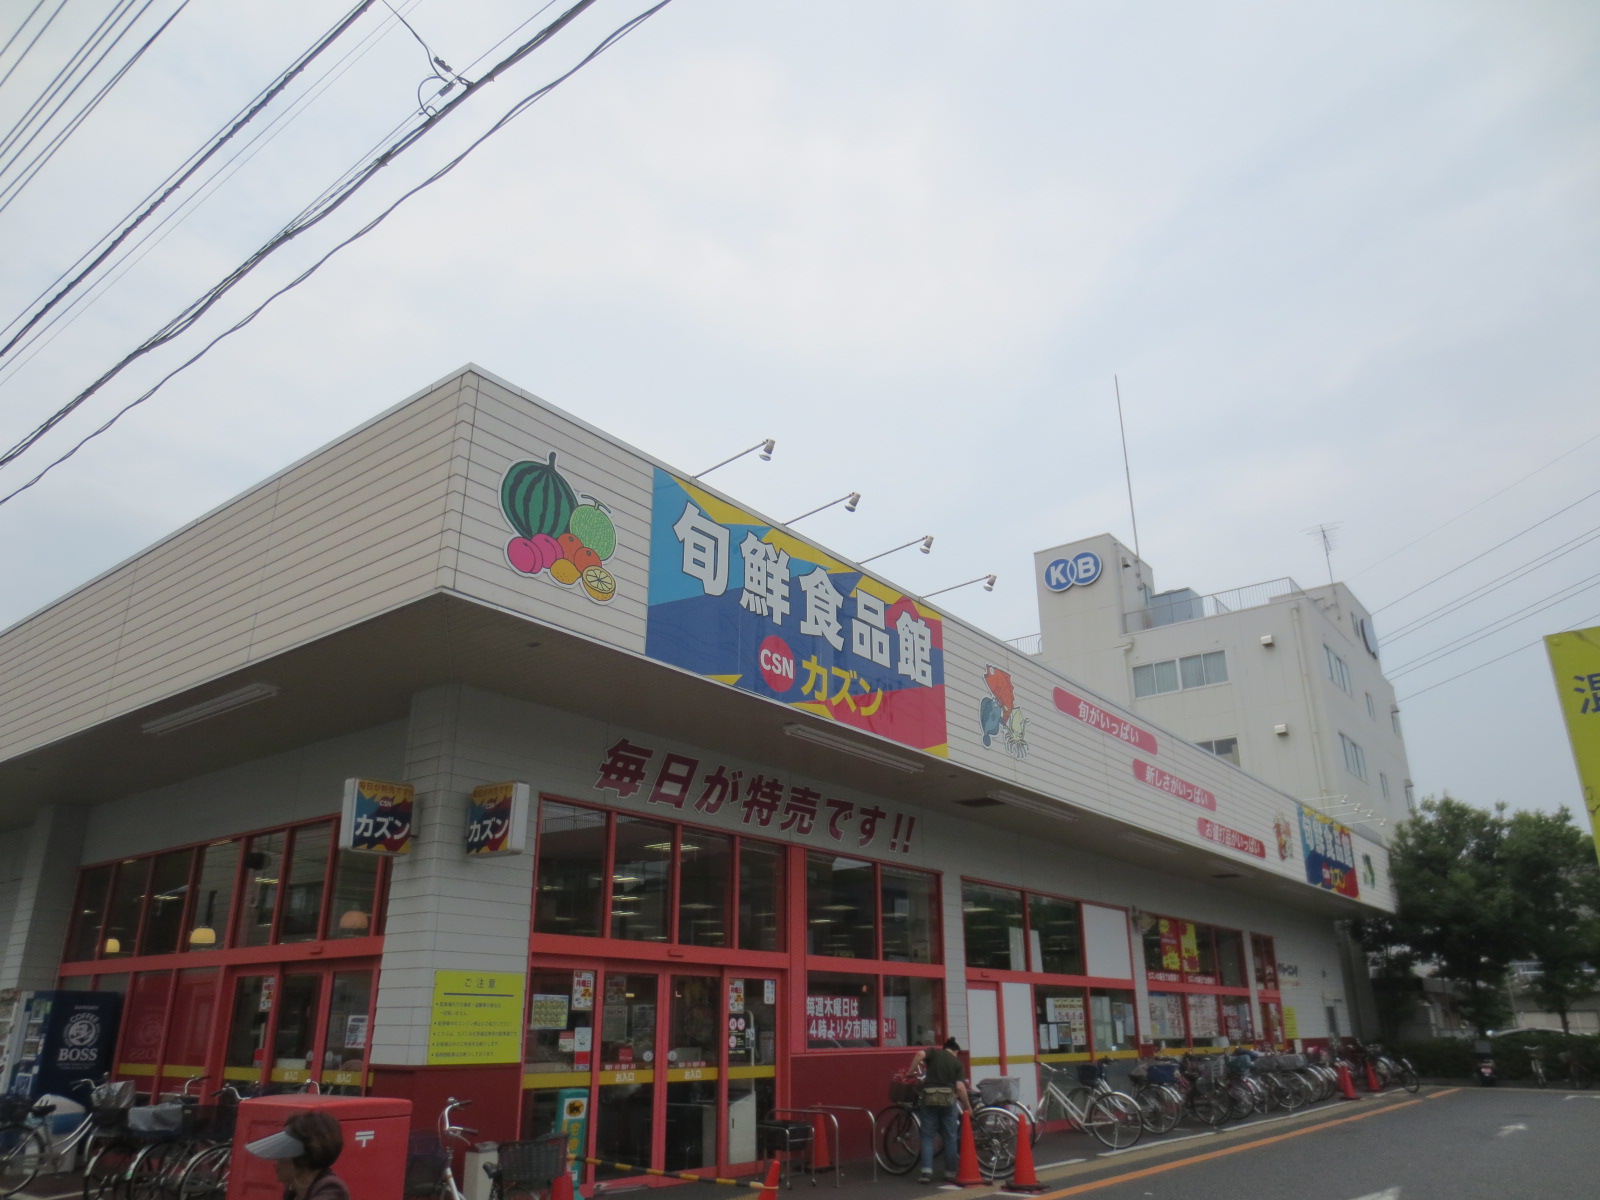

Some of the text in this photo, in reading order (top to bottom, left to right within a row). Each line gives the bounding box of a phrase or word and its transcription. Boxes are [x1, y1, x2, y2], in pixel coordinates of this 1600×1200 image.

[672, 499, 933, 689] 旬鮮食品館
[760, 648, 794, 680] CSN
[801, 655, 883, 717] カズン
[1078, 701, 1139, 743] 旬がいっぱい
[1145, 764, 1209, 805] 新しさがいっぱい
[355, 813, 411, 840] カズン
[468, 816, 509, 843] カズン
[464, 978, 496, 989] ご注意
[69, 1012, 100, 1023] COFFEE
[807, 996, 859, 1018] 毎週木曜日は
[57, 1047, 98, 1061] BOSS
[616, 1073, 635, 1083] お入口
[684, 1070, 702, 1080] お入口
